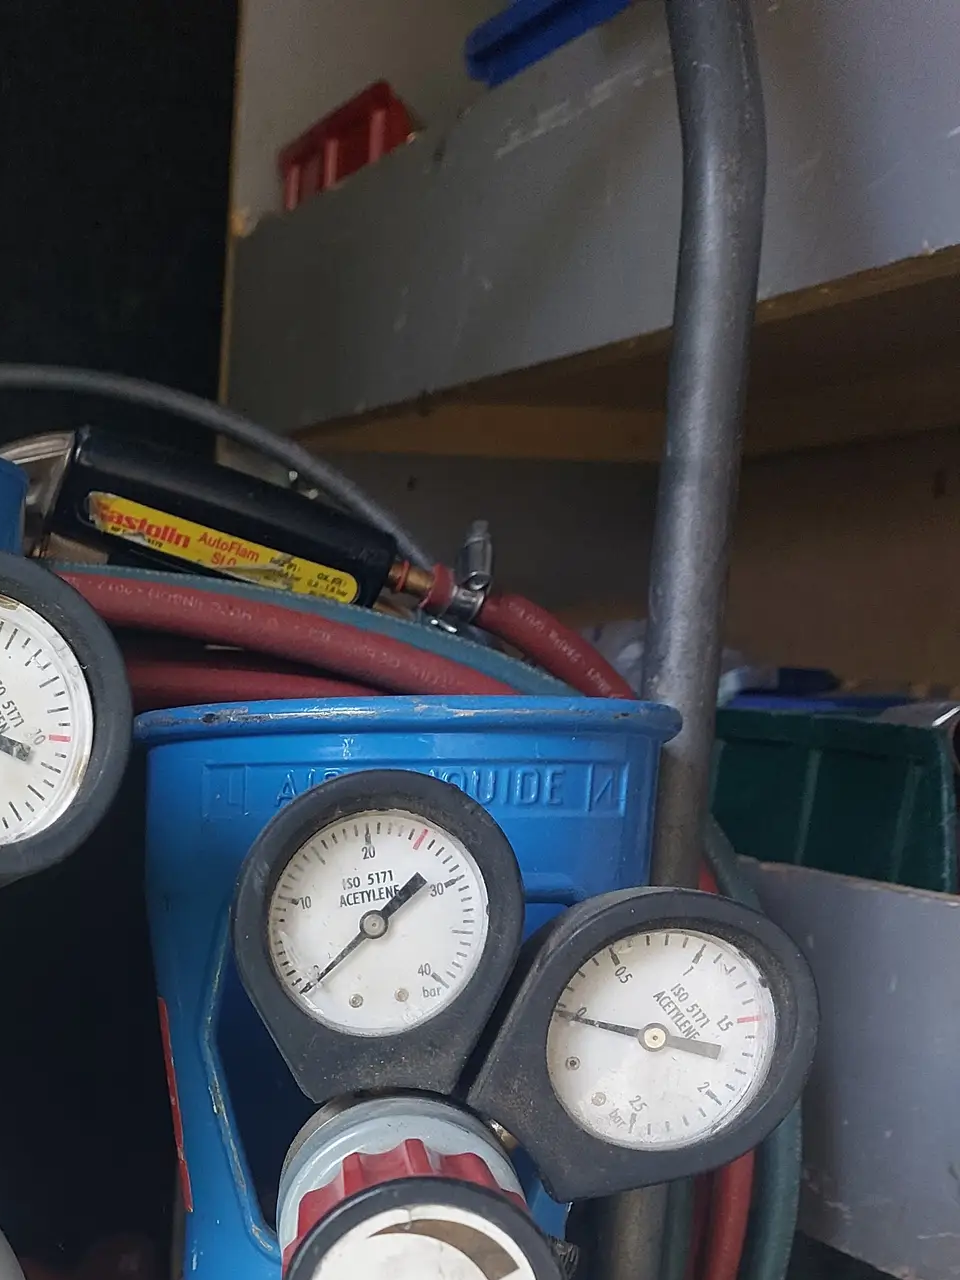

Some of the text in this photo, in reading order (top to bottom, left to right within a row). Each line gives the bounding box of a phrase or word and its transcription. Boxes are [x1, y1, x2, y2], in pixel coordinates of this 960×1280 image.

[198, 531, 260, 564] AutoFlam
[2, 700, 25, 728] 5171
[362, 845, 376, 860] 20
[343, 869, 394, 891] ISO 5171
[340, 883, 401, 908] ACETYLENE
[430, 881, 444, 897] 30
[300, 896, 312, 910] 10
[417, 962, 432, 977] 40
[614, 966, 634, 984] 0.5
[683, 966, 694, 976] 1
[422, 985, 442, 998] bar
[670, 983, 711, 1028] ISO 5171
[696, 1081, 711, 1093] 2
[608, 1107, 626, 1128] bar
